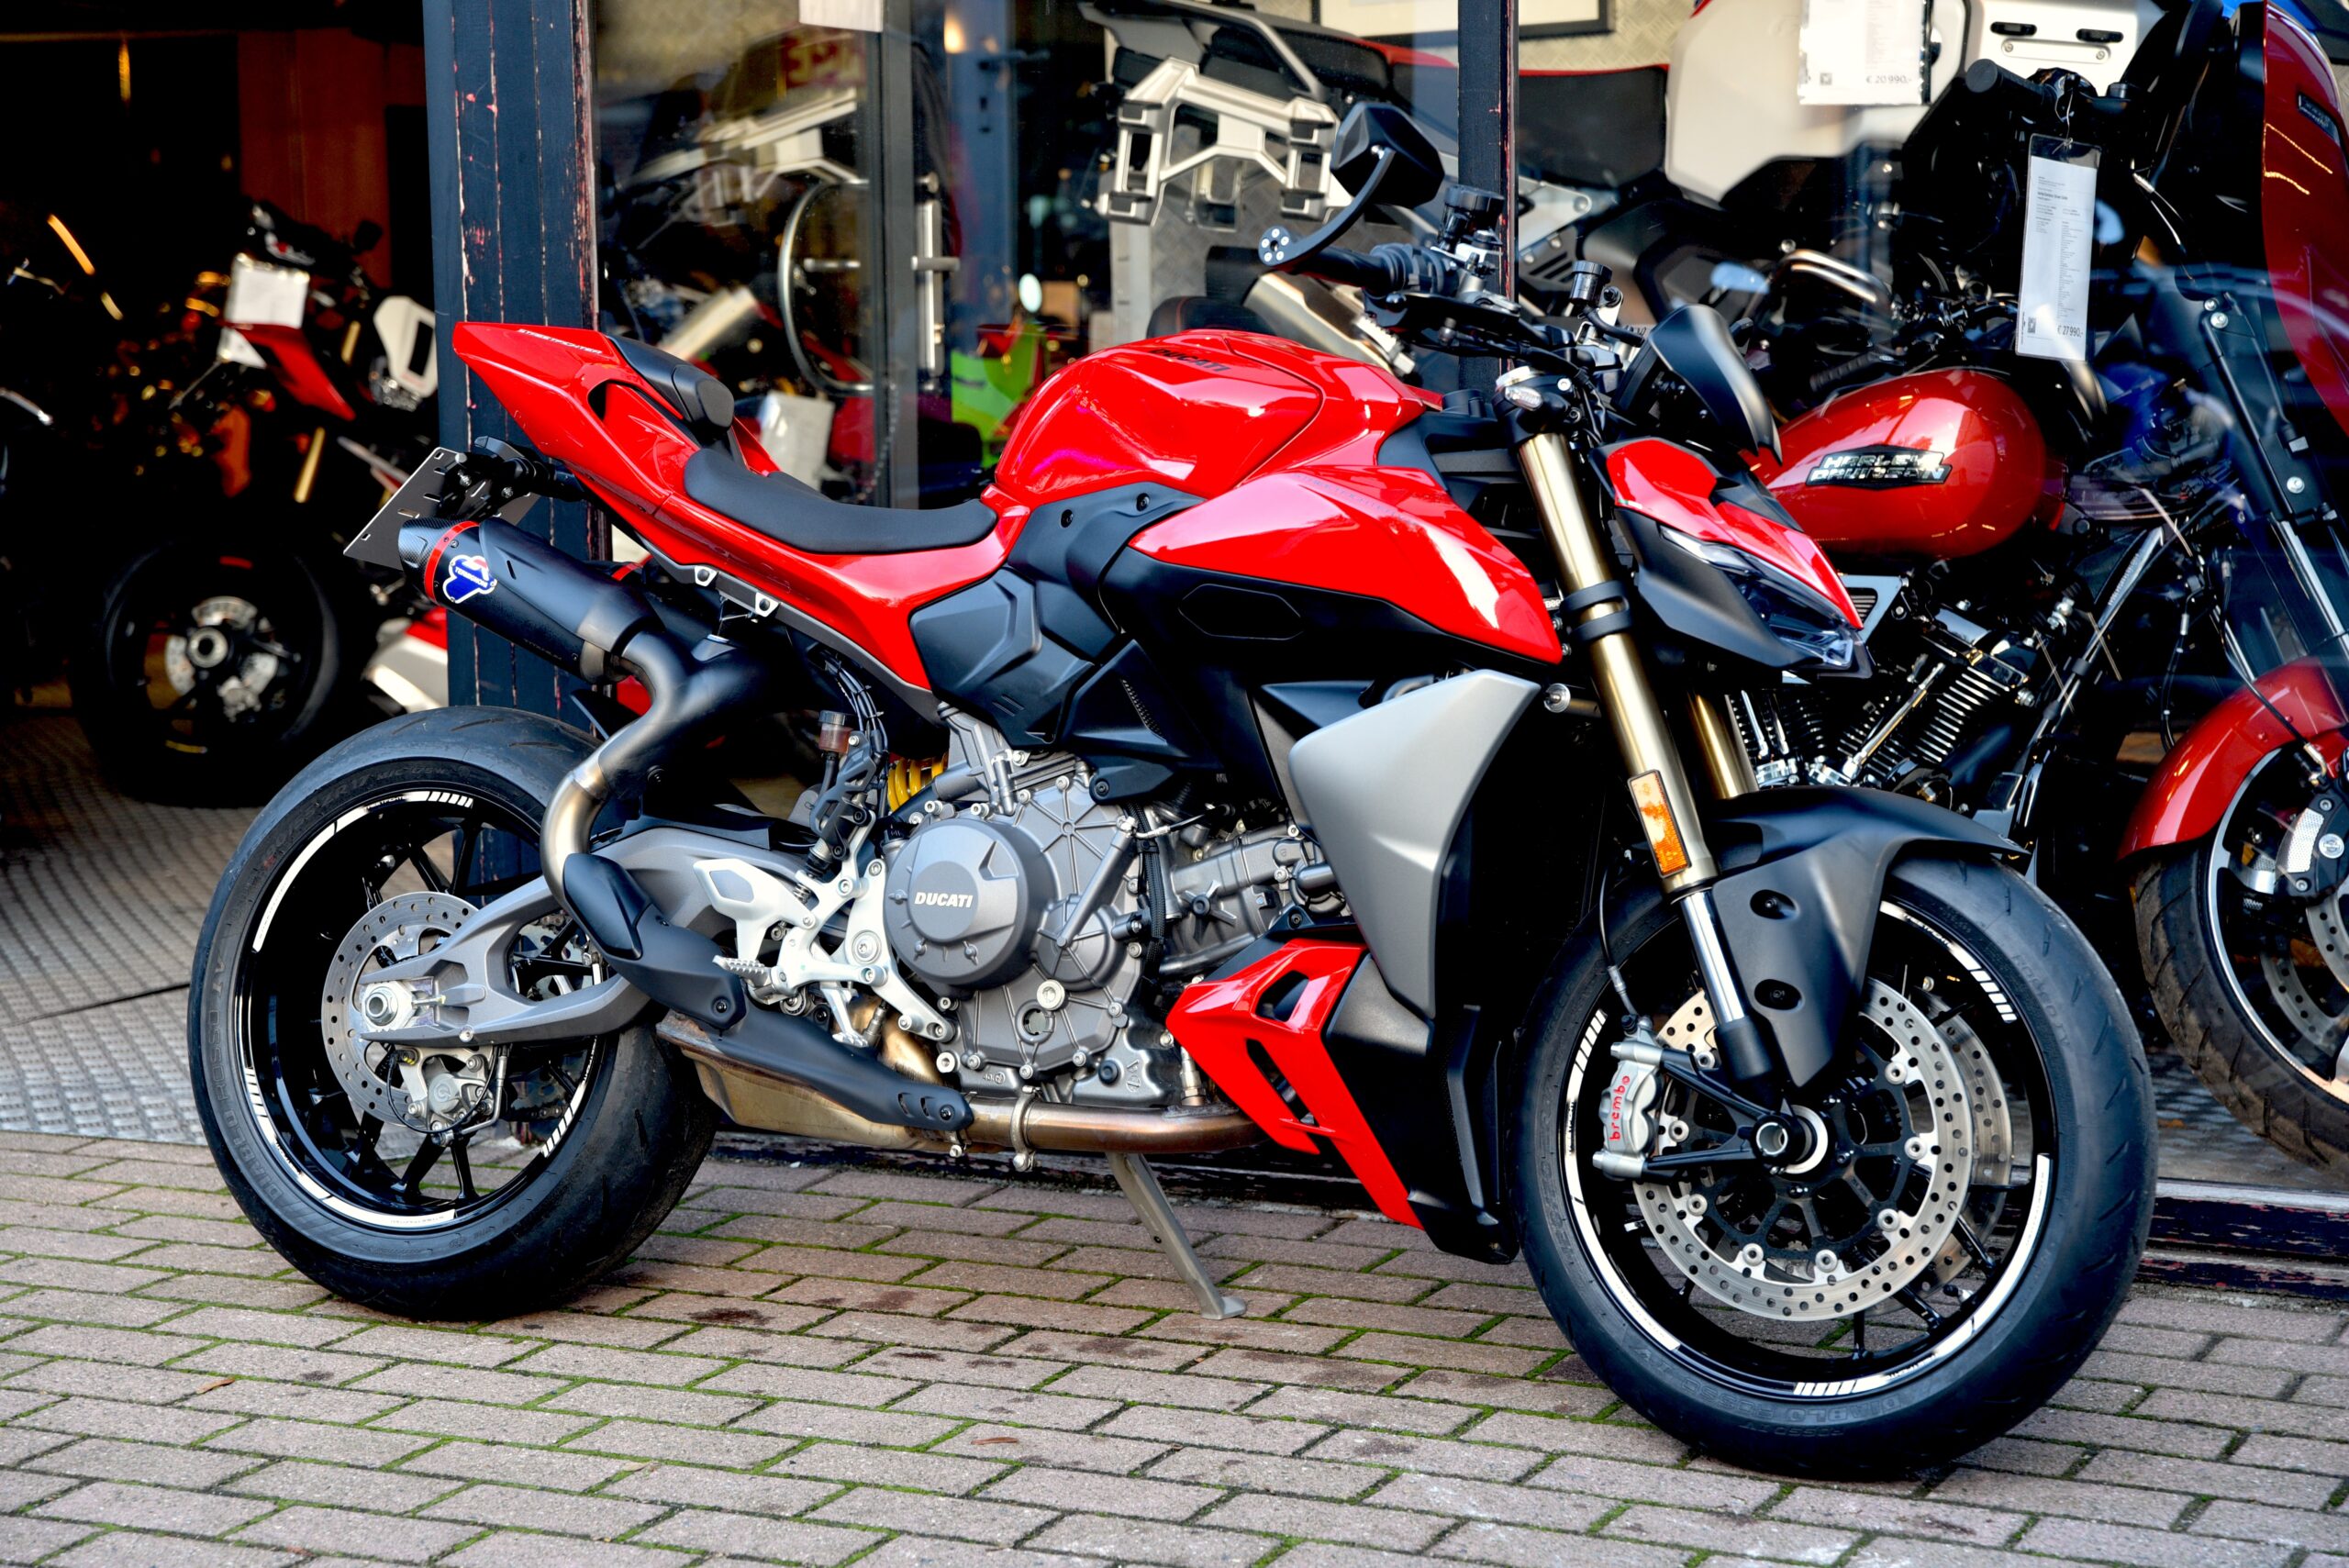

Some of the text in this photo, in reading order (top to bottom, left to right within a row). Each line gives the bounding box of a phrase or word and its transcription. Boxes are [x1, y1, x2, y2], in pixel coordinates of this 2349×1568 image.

[1148, 349, 1231, 373] DUCATI
[914, 892, 974, 908] DUCATI
[203, 1008, 231, 1104] ROSSO
[1609, 1075, 1631, 1141] brembo
[223, 1106, 288, 1202] DIABLO
